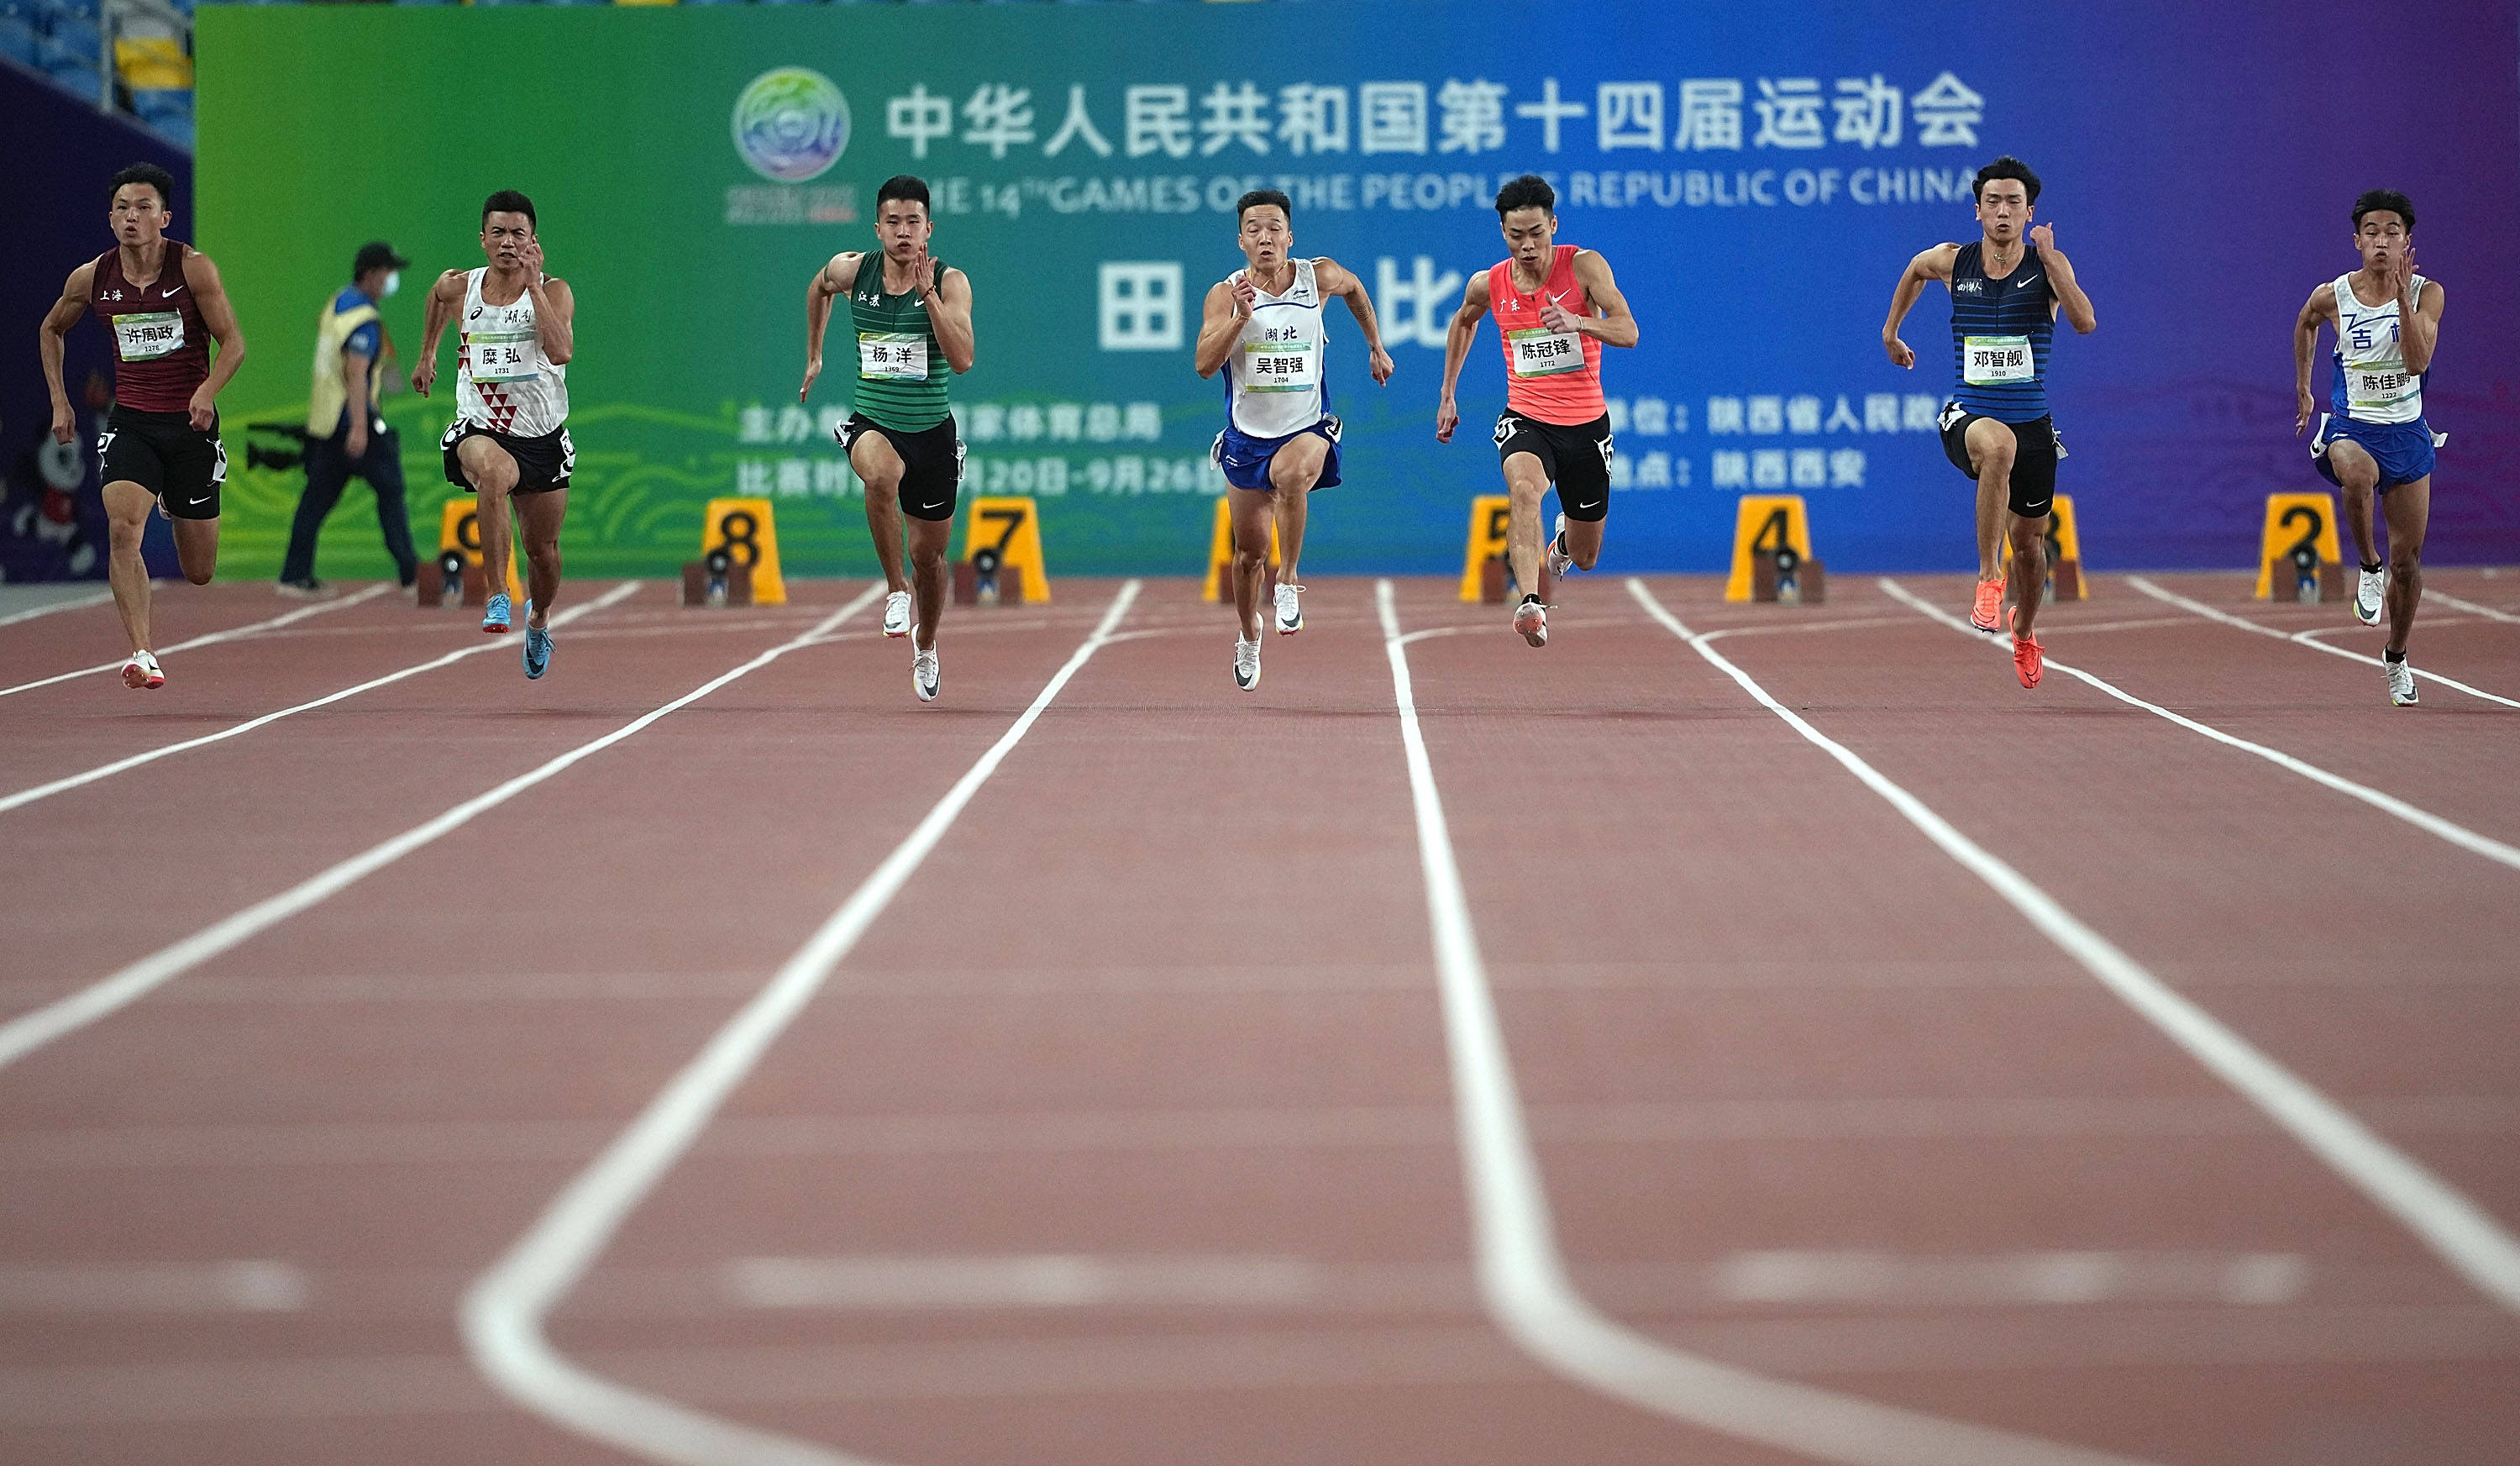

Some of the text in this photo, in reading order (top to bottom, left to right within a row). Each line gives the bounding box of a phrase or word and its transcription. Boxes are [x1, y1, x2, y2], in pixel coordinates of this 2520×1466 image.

[886, 71, 1986, 160] 中华人民共和国第十四届运动会
[927, 176, 969, 213] HE
[1048, 173, 1202, 213] GAMES
[1569, 170, 1778, 208] REPUBLIC
[1783, 169, 1841, 207] OF
[100, 289, 123, 301] 上海
[858, 291, 880, 307] 江苏
[1500, 298, 1520, 312] 广东
[505, 309, 532, 323] 湖南
[126, 326, 174, 344] 许周政
[1265, 325, 1298, 342] 湖北
[144, 344, 160, 353] 1278
[873, 346, 911, 363] 杨洋
[1521, 339, 1571, 360] 陈冠锋
[1256, 357, 1304, 374] 吴智强
[1539, 360, 1556, 368] 1772
[1974, 350, 2023, 367] 邓智舰
[722, 512, 760, 567] 8
[981, 509, 1024, 556] 7
[1753, 507, 1788, 555] 4
[2281, 507, 2321, 556] 2
